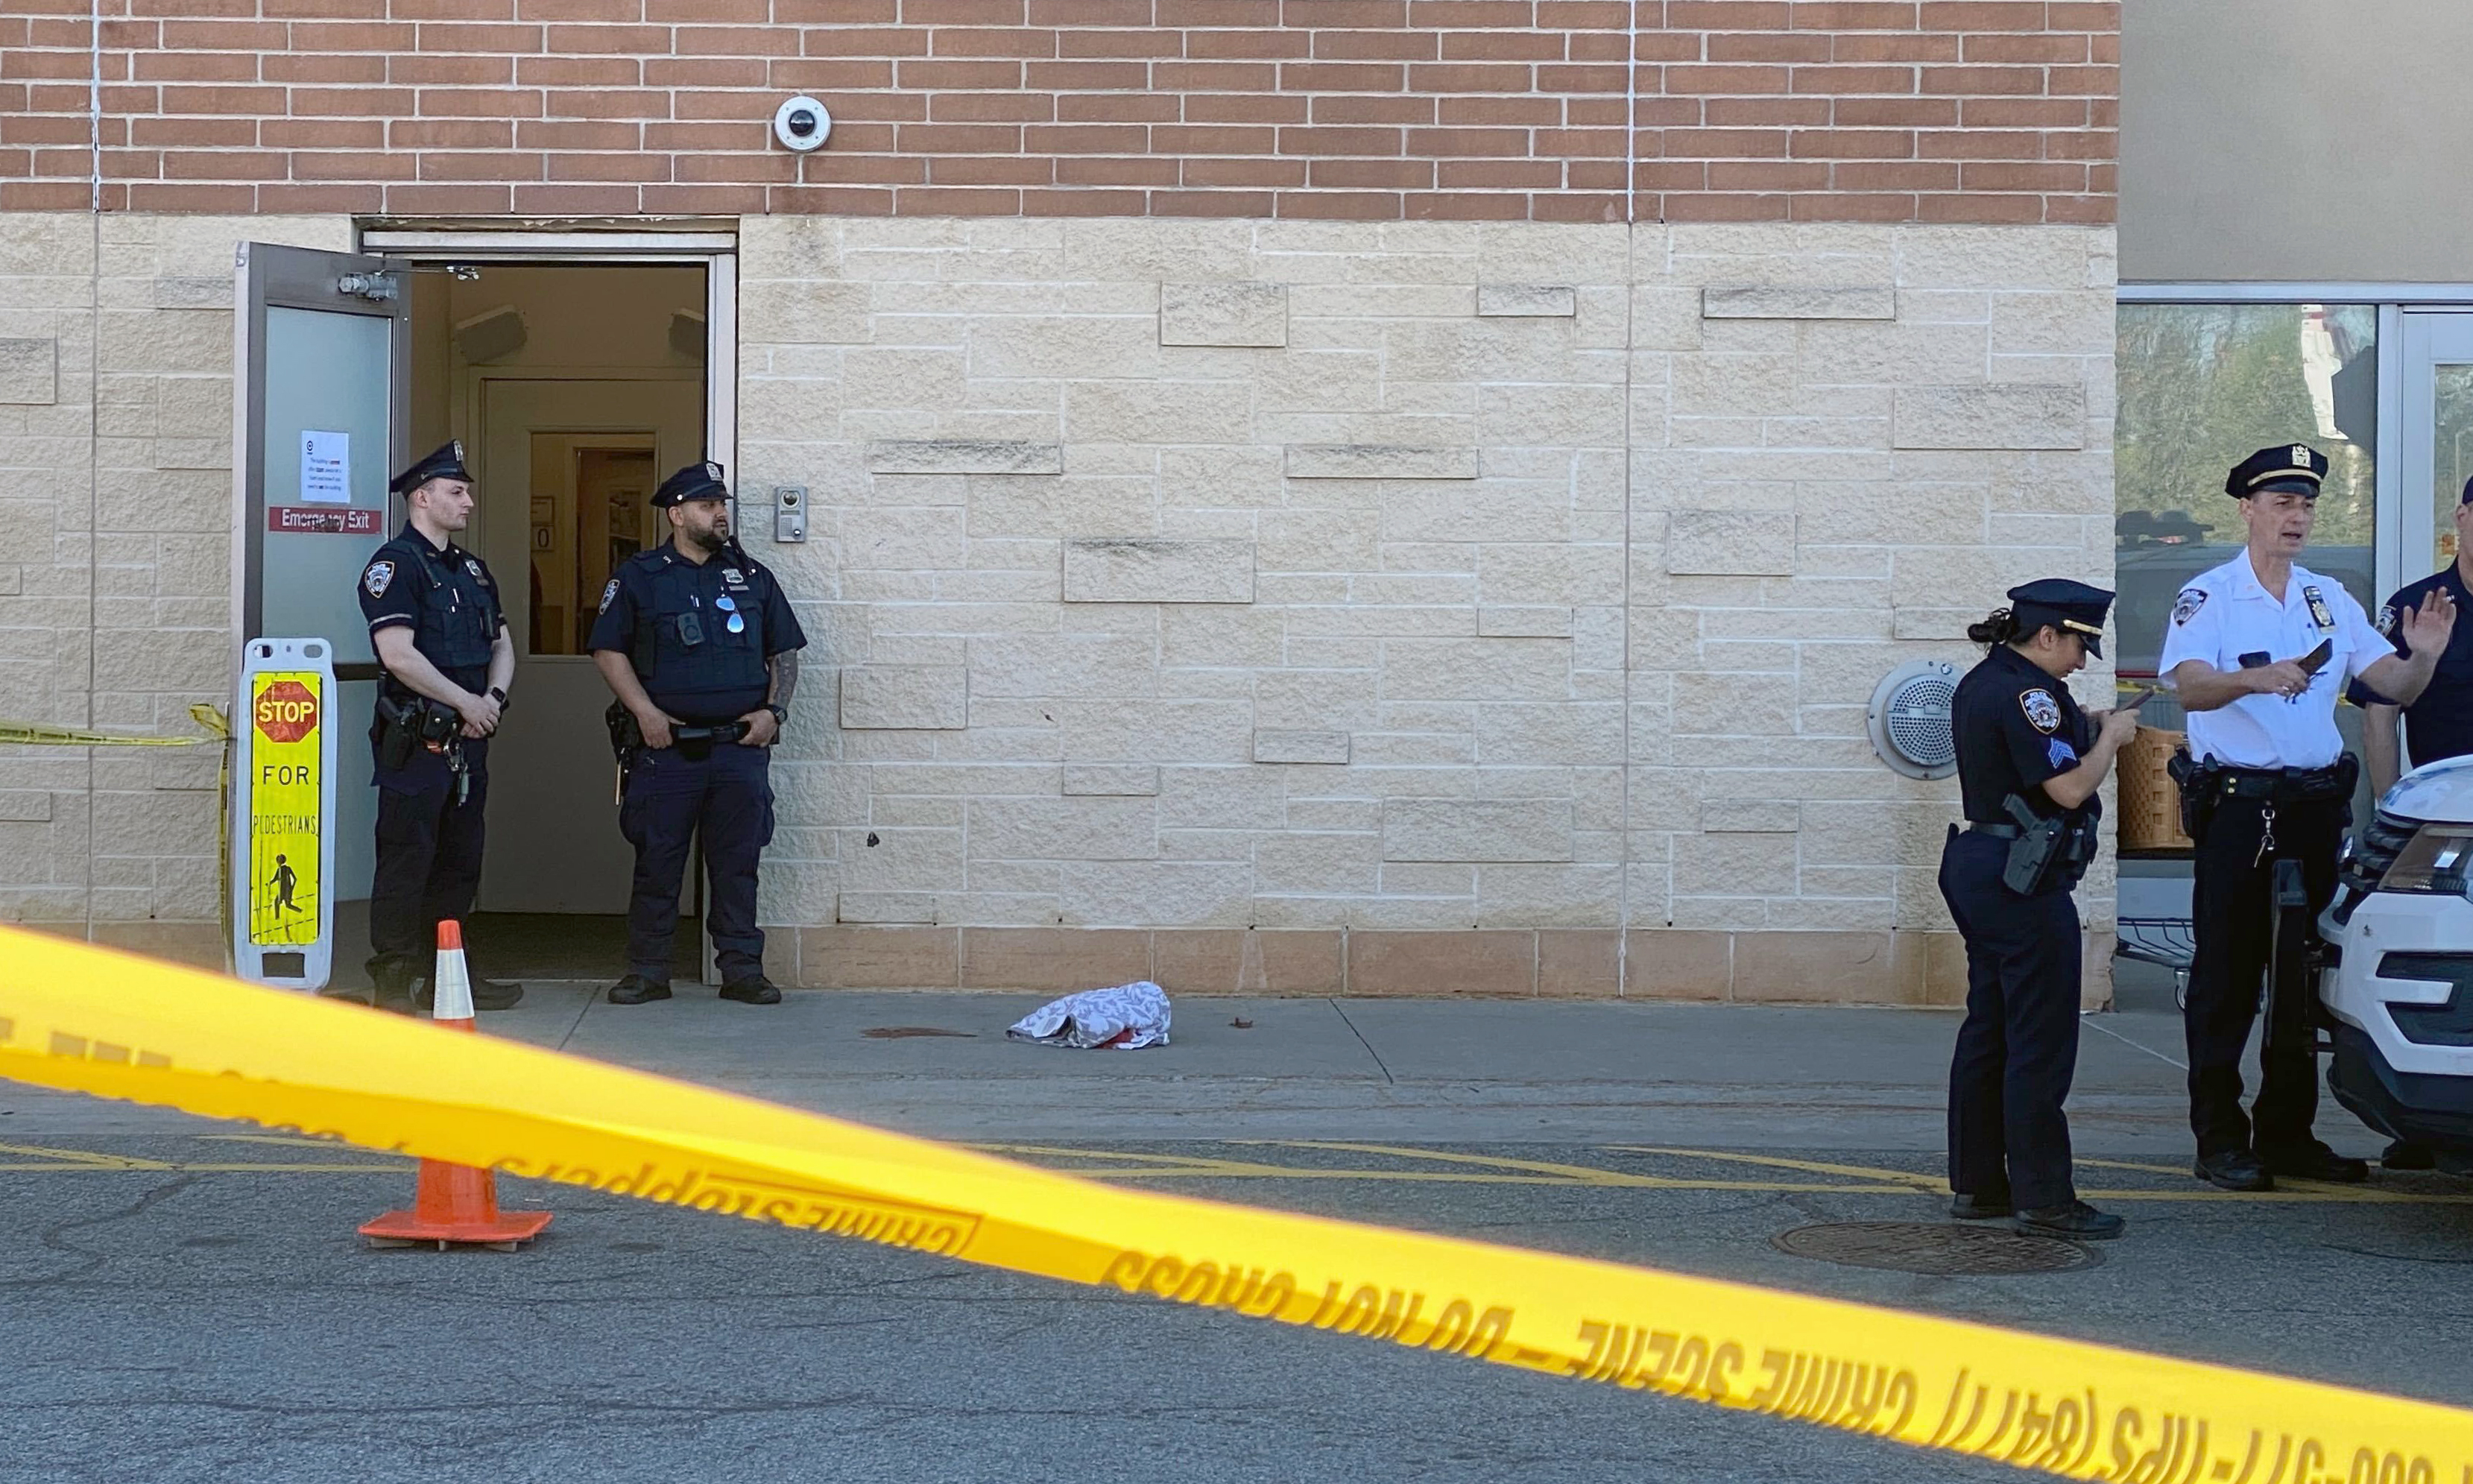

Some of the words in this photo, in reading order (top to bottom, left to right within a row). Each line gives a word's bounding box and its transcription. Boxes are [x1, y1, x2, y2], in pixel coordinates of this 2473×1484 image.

[348, 511, 370, 529] Exit
[259, 701, 315, 723] STOP
[263, 765, 309, 786] FOR
[253, 815, 317, 835] PEDESTRIANS
[1103, 1249, 1297, 1314] CROSS
[1313, 1280, 1427, 1339] NOT
[1427, 1299, 1515, 1357] DO
[1575, 1320, 1745, 1400] SCENE
[1752, 1349, 1918, 1433] CRIME
